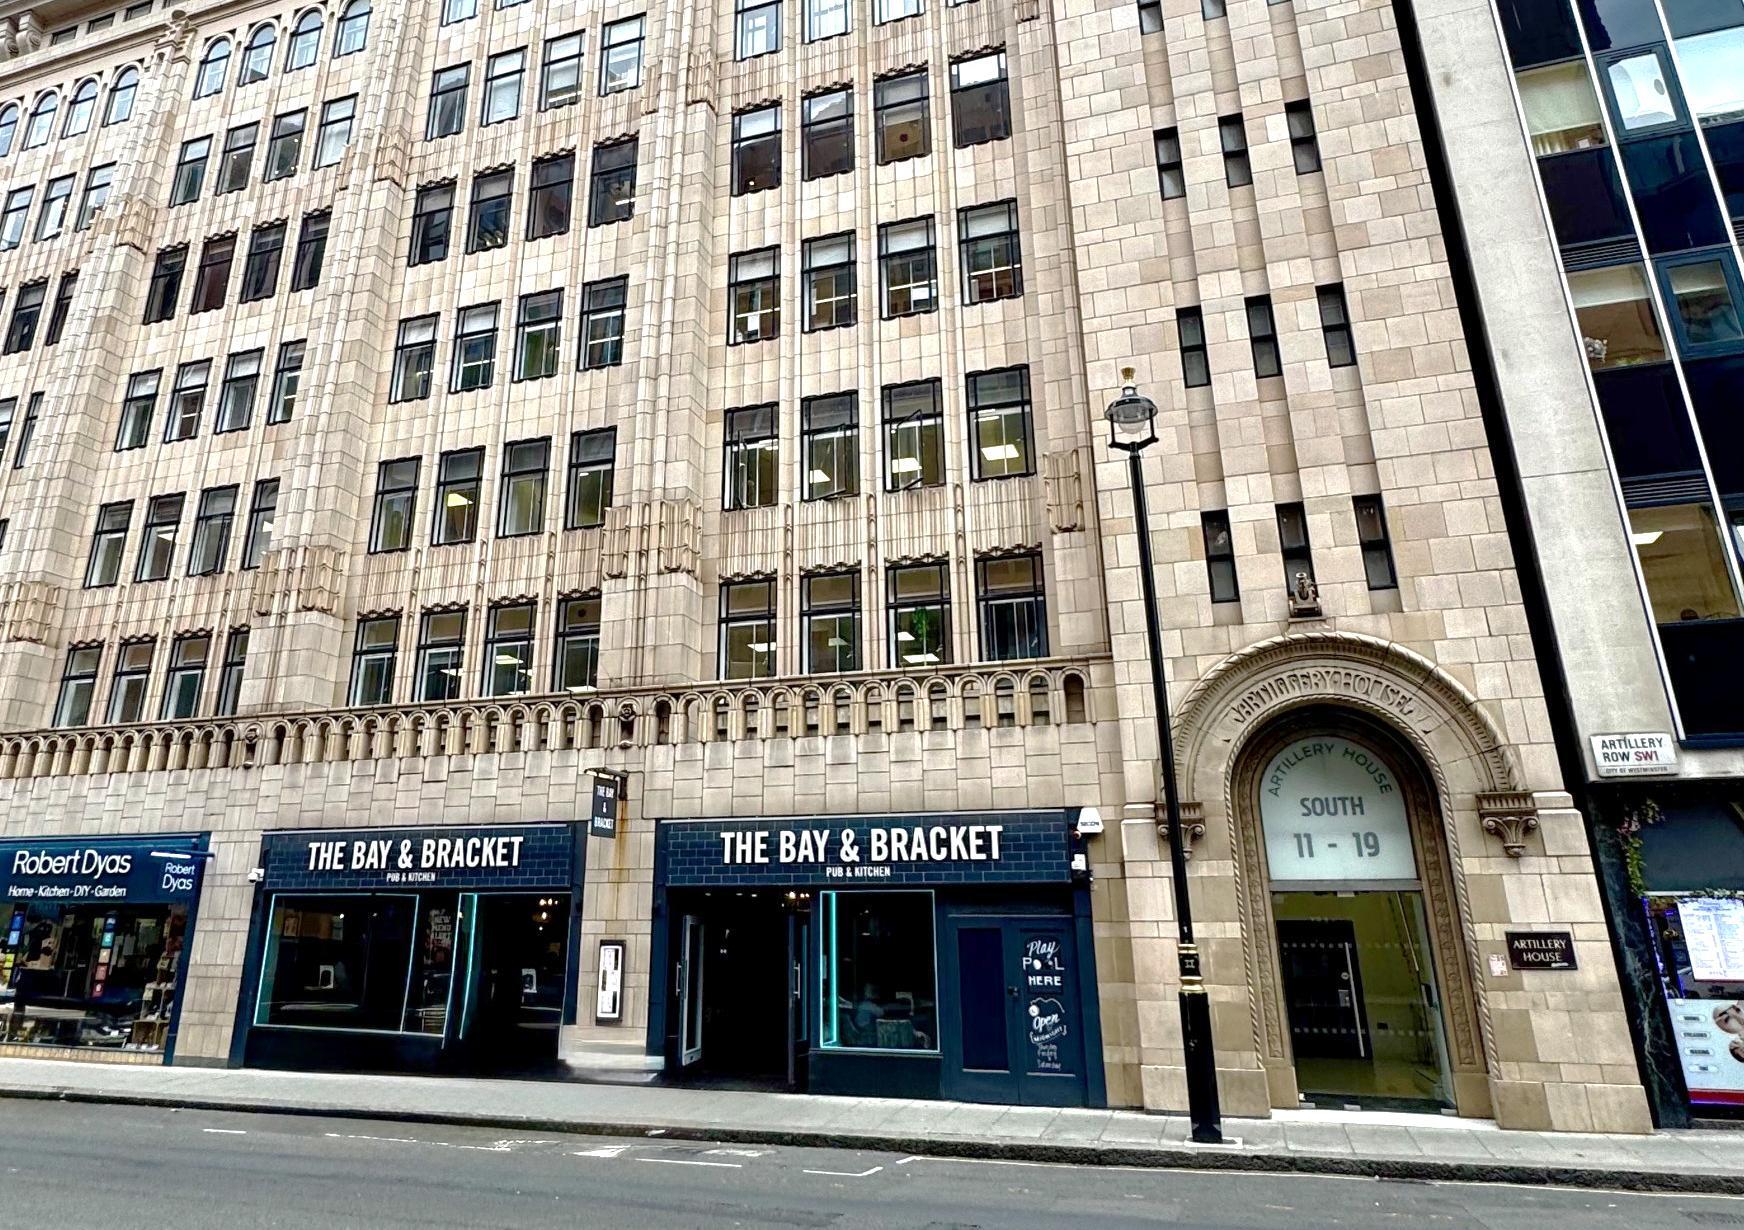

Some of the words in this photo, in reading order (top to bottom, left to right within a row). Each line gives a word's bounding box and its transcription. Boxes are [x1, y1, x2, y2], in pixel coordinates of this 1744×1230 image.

[1601, 736, 1663, 750] ARTILLERY
[1602, 750, 1630, 763] ROW
[1634, 750, 1659, 761] SW1
[1268, 742, 1335, 797] ARTILLERY
[1342, 747, 1393, 794] HOUSE
[1300, 796, 1365, 817] SOUTH
[720, 830, 769, 864] THE
[779, 829, 830, 863] BAY
[840, 828, 860, 862] &
[870, 825, 1003, 862] BRACKET
[1293, 832, 1315, 858] 11
[1352, 831, 1380, 858] 19
[308, 841, 347, 871] THE
[351, 839, 393, 870] BAY
[397, 838, 413, 869] &
[420, 836, 524, 869] BRACKET
[12, 850, 79, 874] Robert
[81, 849, 132, 879] Dyas
[164, 862, 195, 875] Robert
[825, 866, 843, 877] PUB
[846, 867, 853, 877] &
[854, 866, 891, 877] KITCHEN
[162, 874, 193, 892] Dyas
[386, 873, 399, 882] PUB
[401, 873, 407, 882] &
[408, 872, 436, 882] KITCHEN
[8, 885, 34, 897] Home
[38, 884, 70, 897] Kitchen
[73, 885, 91, 897] DIY
[94, 884, 127, 897] Garden
[1027, 940, 1060, 959] Play
[1512, 939, 1566, 949] ARTILLERY
[1522, 951, 1562, 962] HOUSE
[1028, 976, 1062, 986] HERE
[1033, 1013, 1060, 1032] Open
